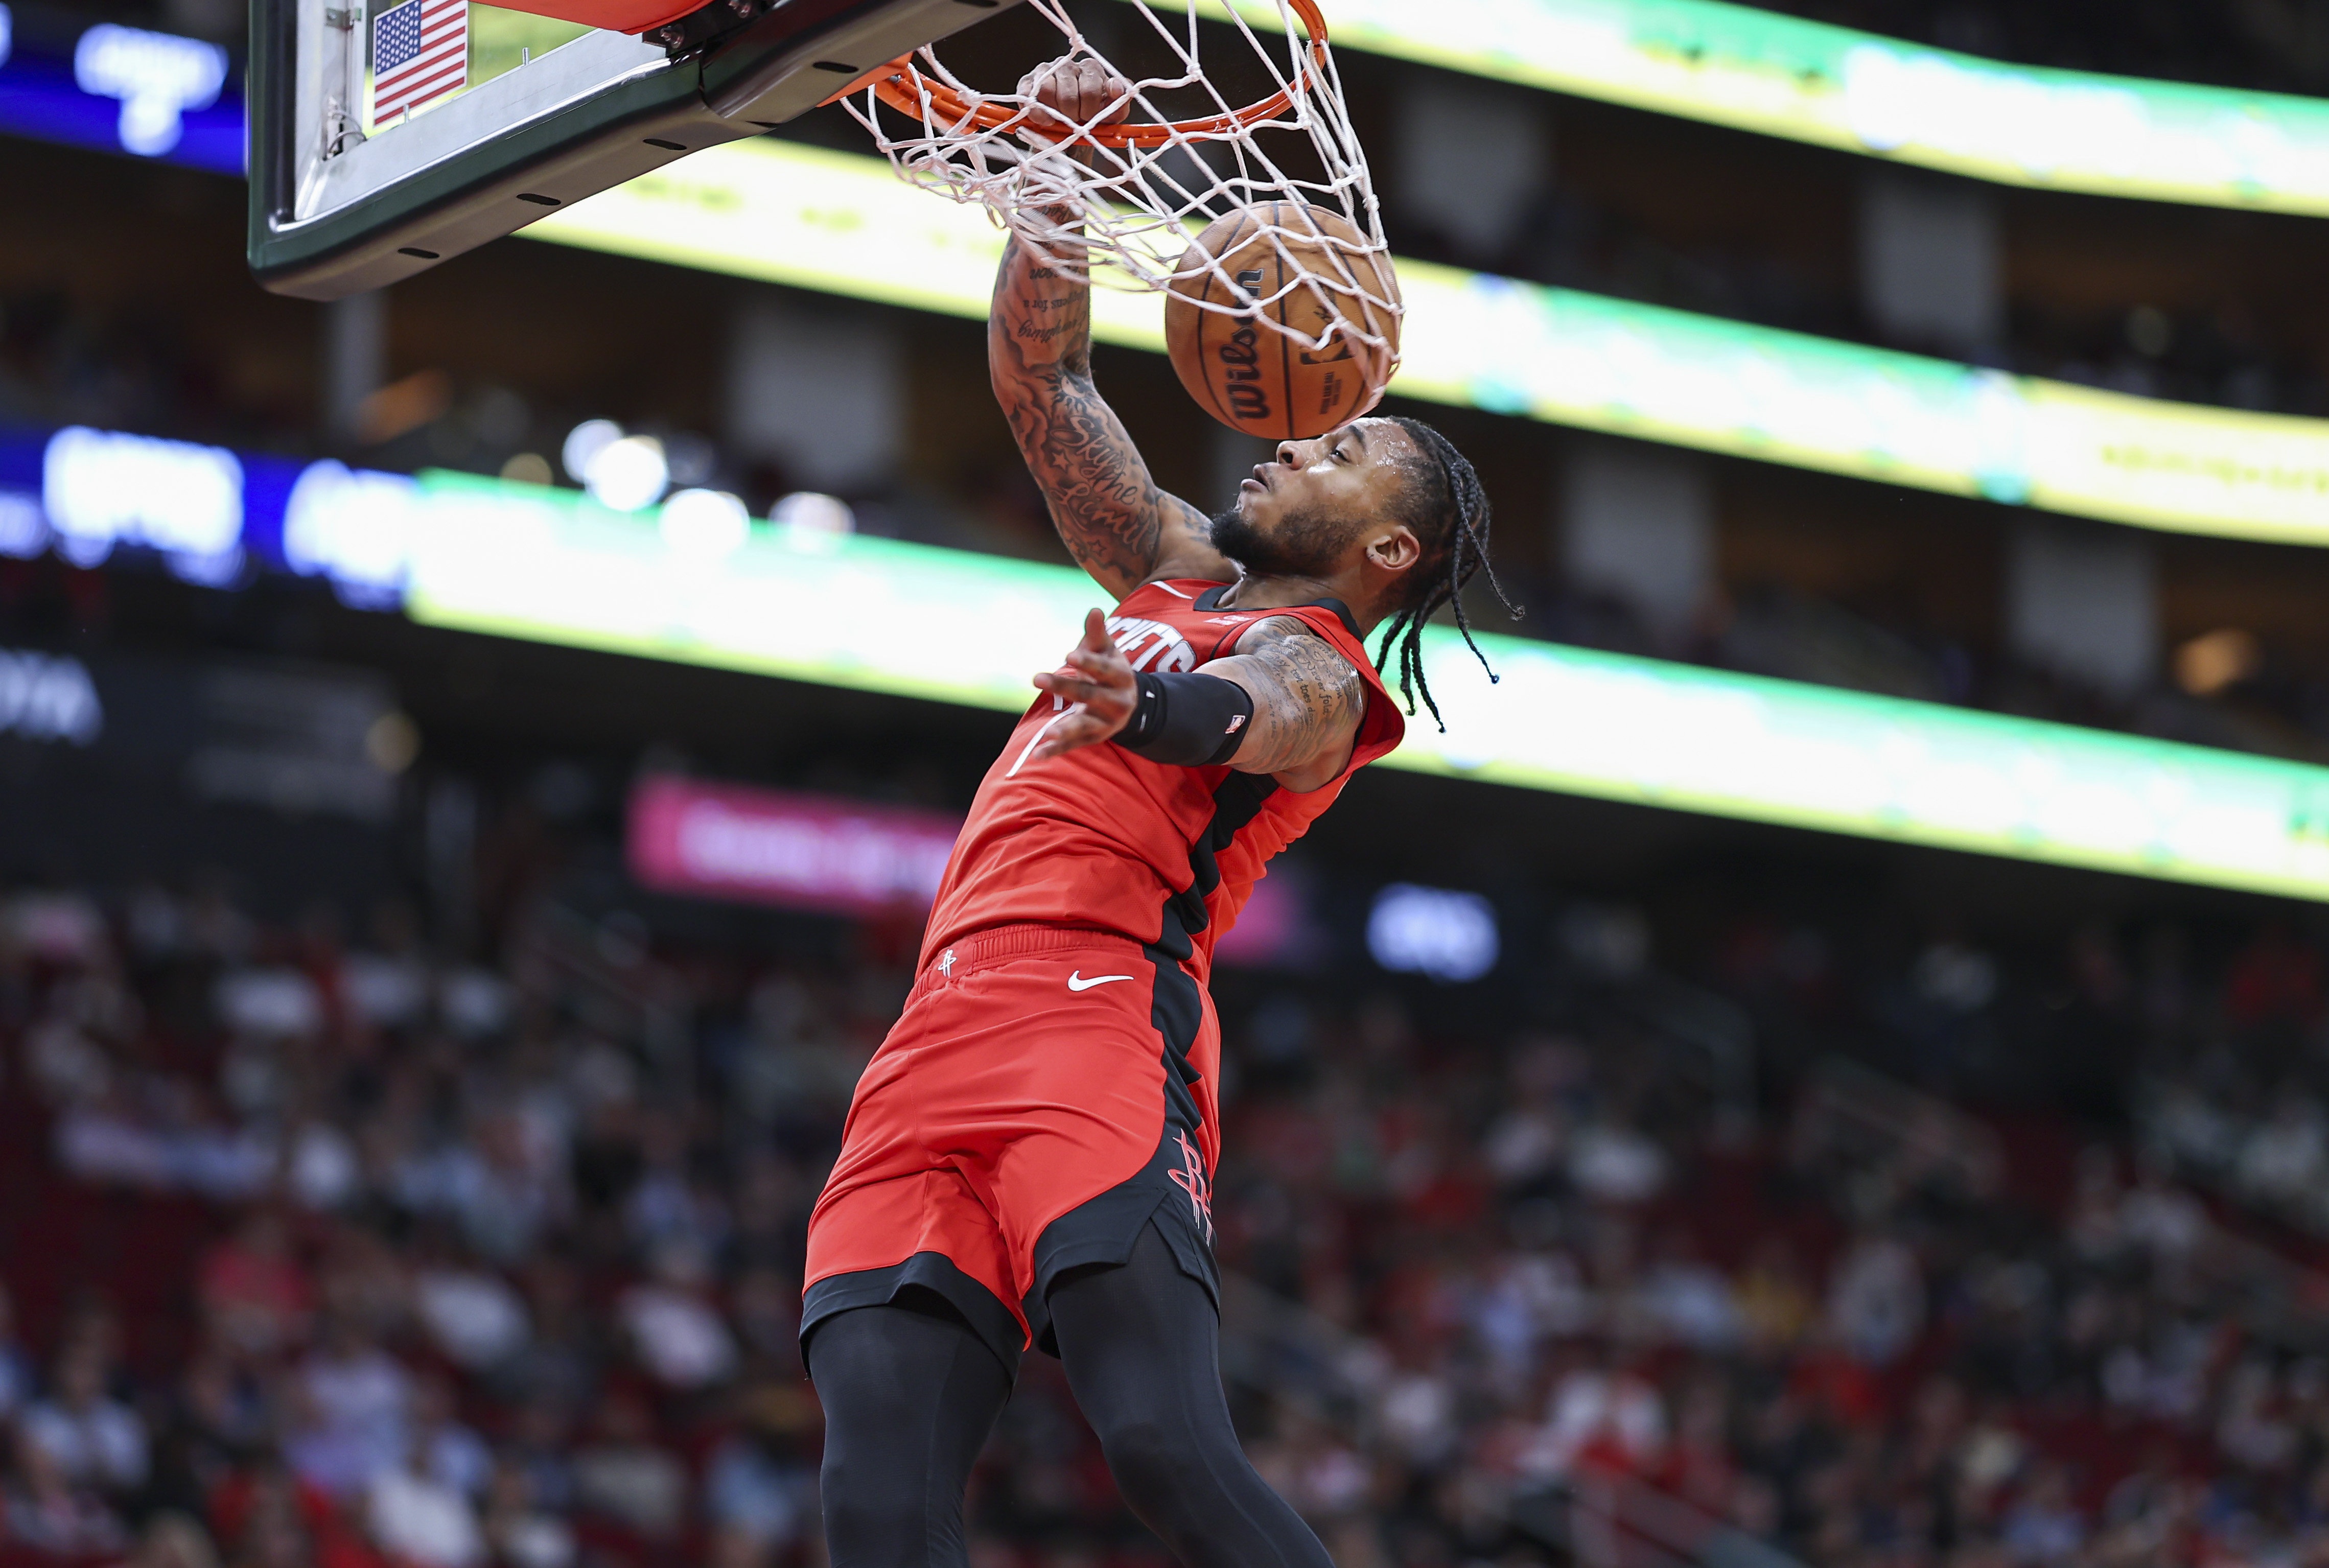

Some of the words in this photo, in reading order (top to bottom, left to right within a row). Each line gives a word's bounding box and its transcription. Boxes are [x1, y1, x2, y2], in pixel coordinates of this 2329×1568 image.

[1033, 300, 1048, 312] for
[1300, 684, 1311, 703] toes
[1319, 693, 1332, 715] fold
